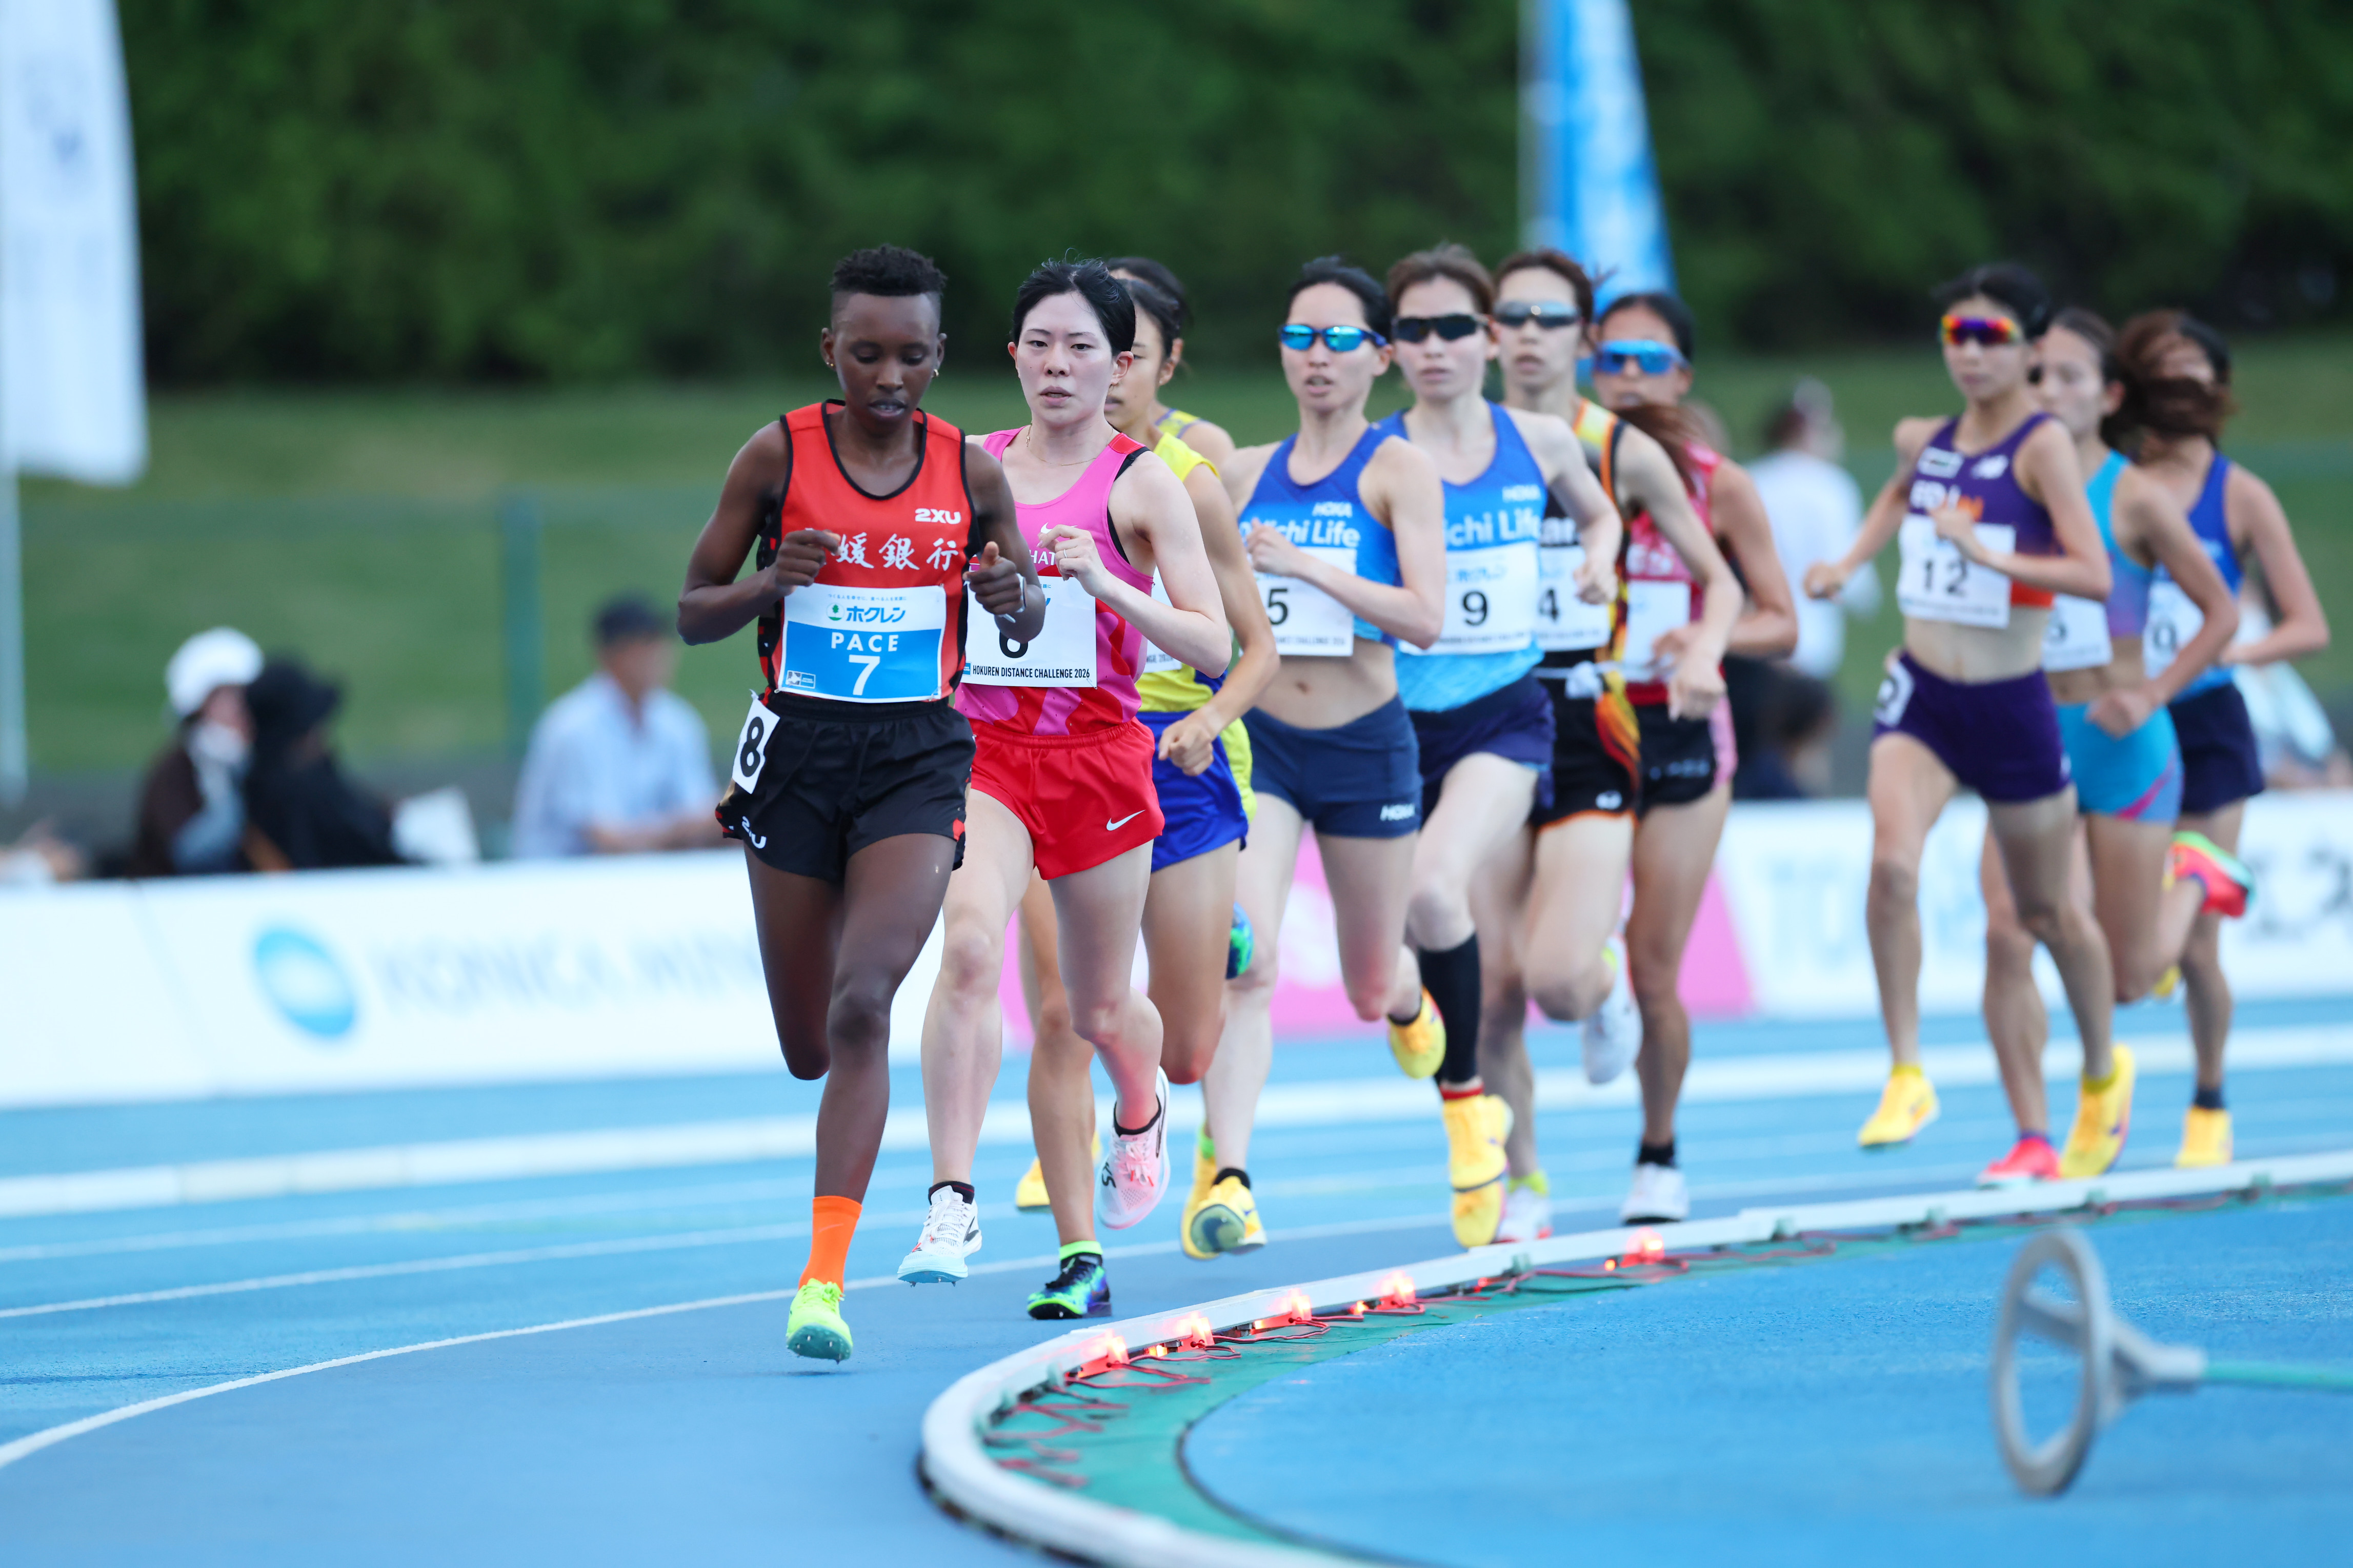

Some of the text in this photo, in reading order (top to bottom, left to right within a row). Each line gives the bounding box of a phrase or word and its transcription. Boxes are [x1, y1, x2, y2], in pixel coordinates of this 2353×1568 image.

[915, 508, 961, 524] 2XU
[1312, 520, 1361, 547] Life
[831, 532, 959, 571] 媛銀行
[846, 606, 906, 623] ホクレン
[1268, 588, 1289, 625] 5
[1462, 590, 1489, 626] 9
[831, 632, 899, 652] PACE
[849, 654, 880, 696] 7
[973, 665, 999, 676] HOKUREN
[1001, 667, 1033, 678] DISTANCE
[1034, 668, 1073, 678] CHALLENGE
[1074, 668, 1090, 678] 2026
[740, 717, 764, 777] 8
